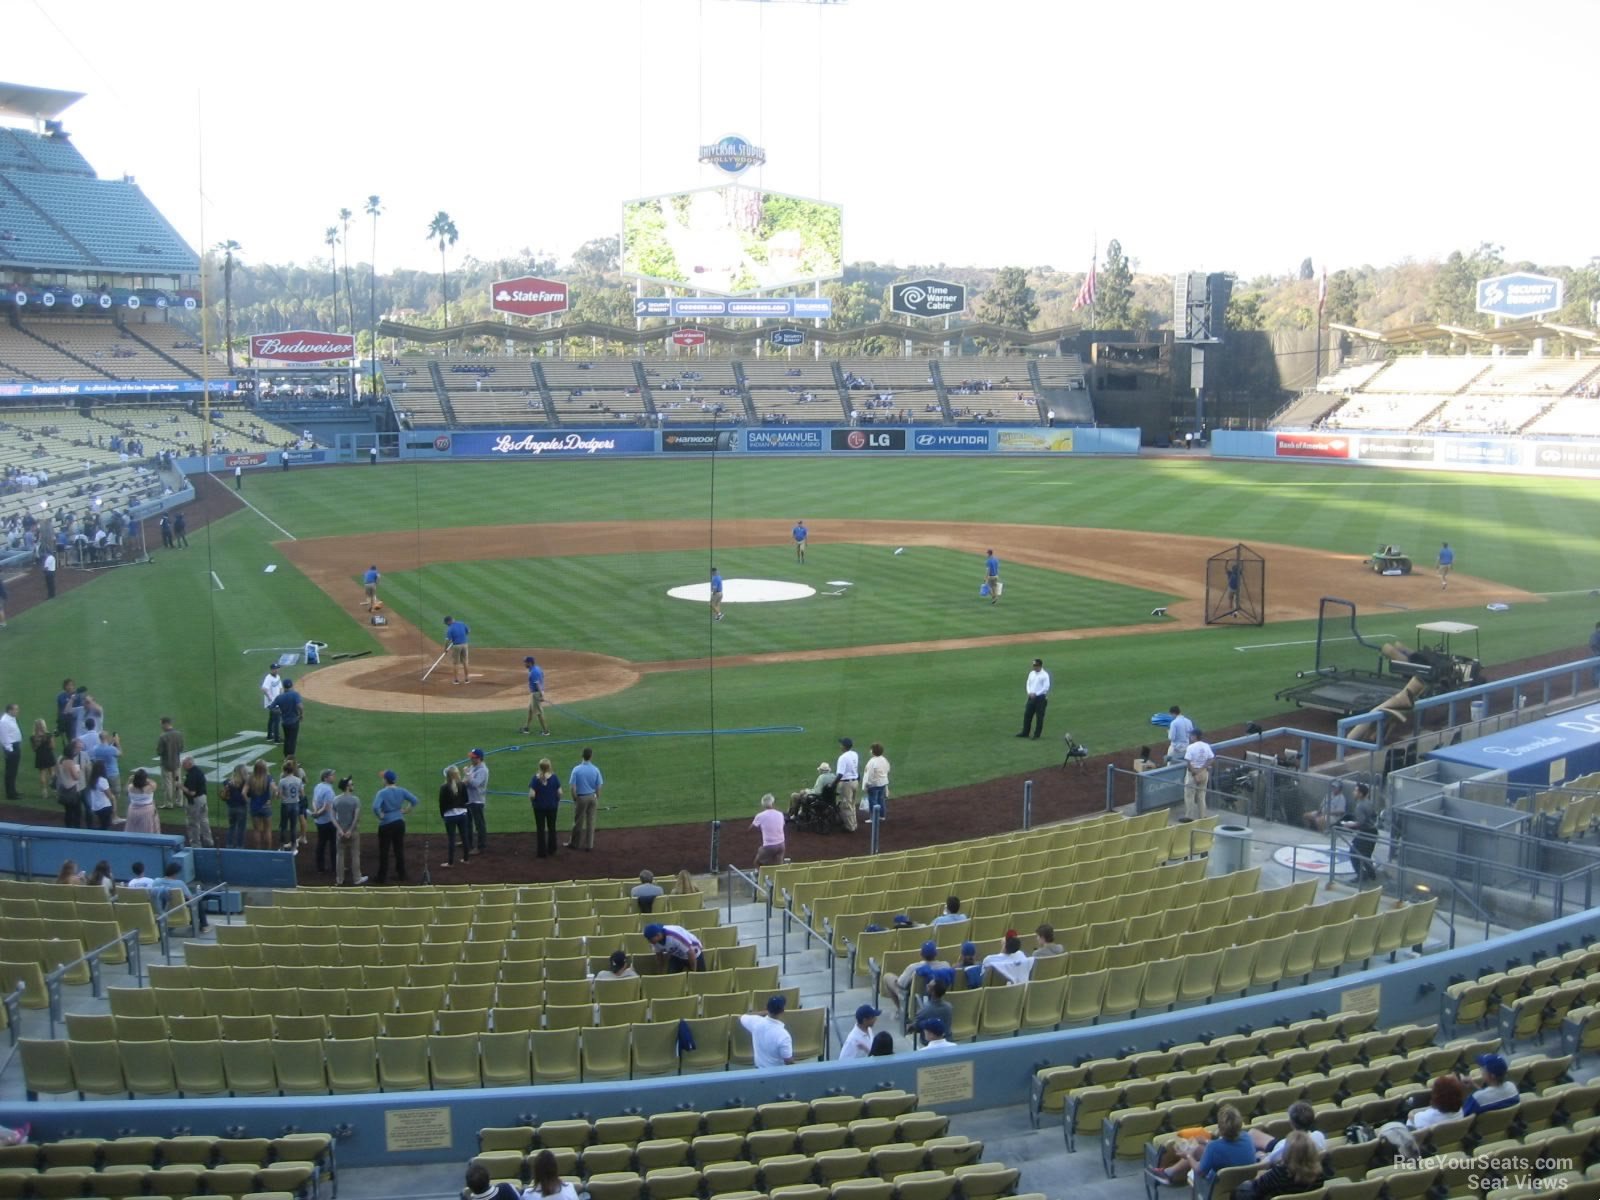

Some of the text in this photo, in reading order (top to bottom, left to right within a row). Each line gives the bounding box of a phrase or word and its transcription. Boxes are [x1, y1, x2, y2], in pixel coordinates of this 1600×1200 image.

[926, 286, 949, 294] Time
[511, 290, 565, 302] State Farm
[926, 294, 958, 302] Warner
[926, 302, 952, 310] Cable
[255, 338, 353, 355] Budweiser
[32, 384, 60, 394] Donate
[238, 381, 253, 389] 6:16
[749, 432, 820, 442] SAN MANUEL
[869, 433, 890, 447] LG
[938, 435, 988, 445] HYUNDAI
[491, 433, 615, 454] Los Angeles Dodgers
[1279, 441, 1296, 449] Bank
